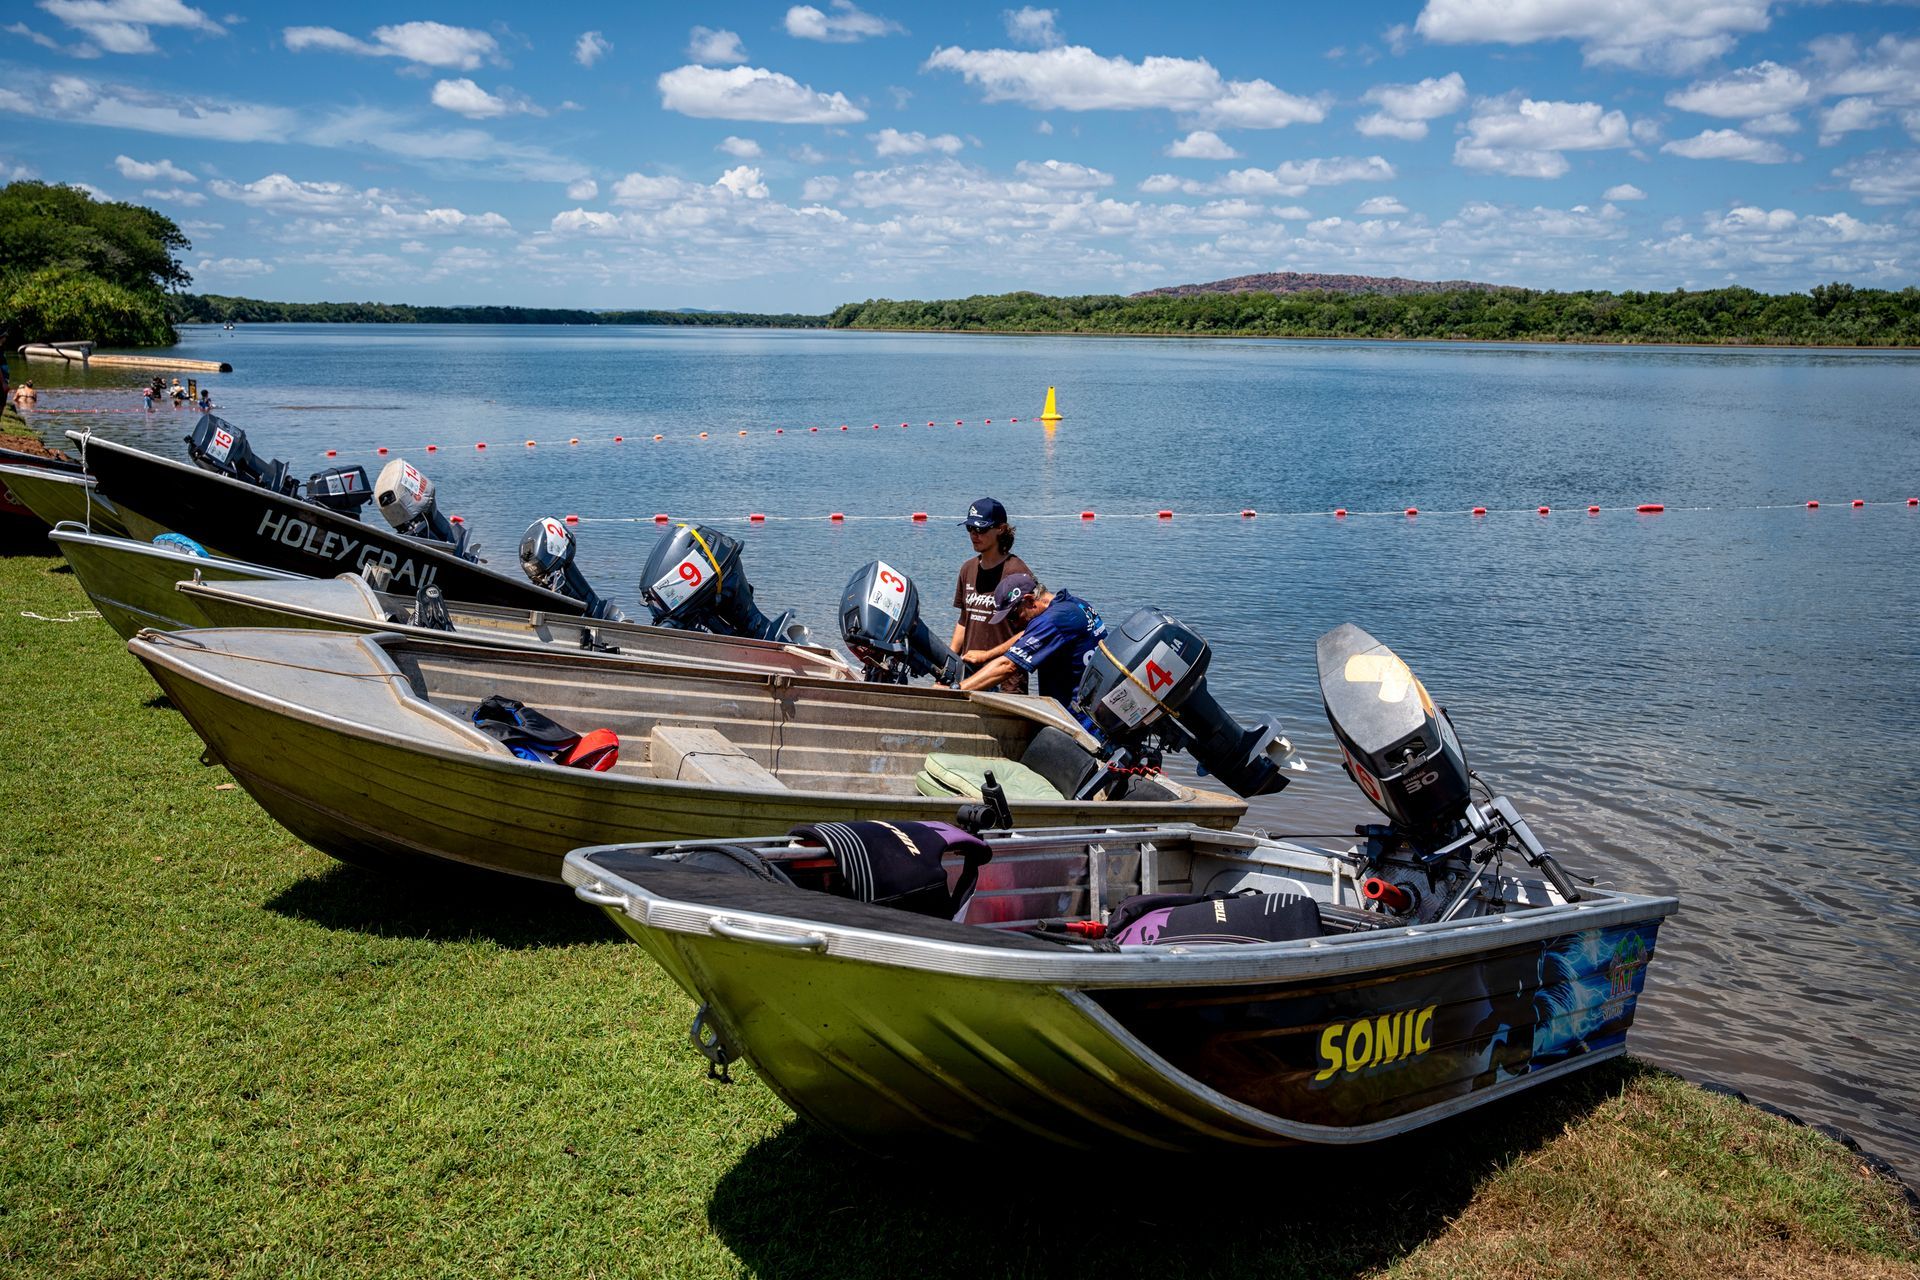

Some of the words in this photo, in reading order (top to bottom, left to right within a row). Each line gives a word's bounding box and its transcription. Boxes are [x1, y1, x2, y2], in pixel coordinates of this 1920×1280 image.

[215, 430, 234, 450] 15
[344, 473, 355, 491] 7
[405, 464, 419, 482] 14
[256, 508, 360, 561] HOLEY
[546, 523, 564, 539] 2
[678, 562, 703, 588] 9
[880, 570, 905, 593] 3
[1145, 659, 1175, 693] 4
[1405, 771, 1439, 794] 30
[1315, 1004, 1438, 1081] SONIC
